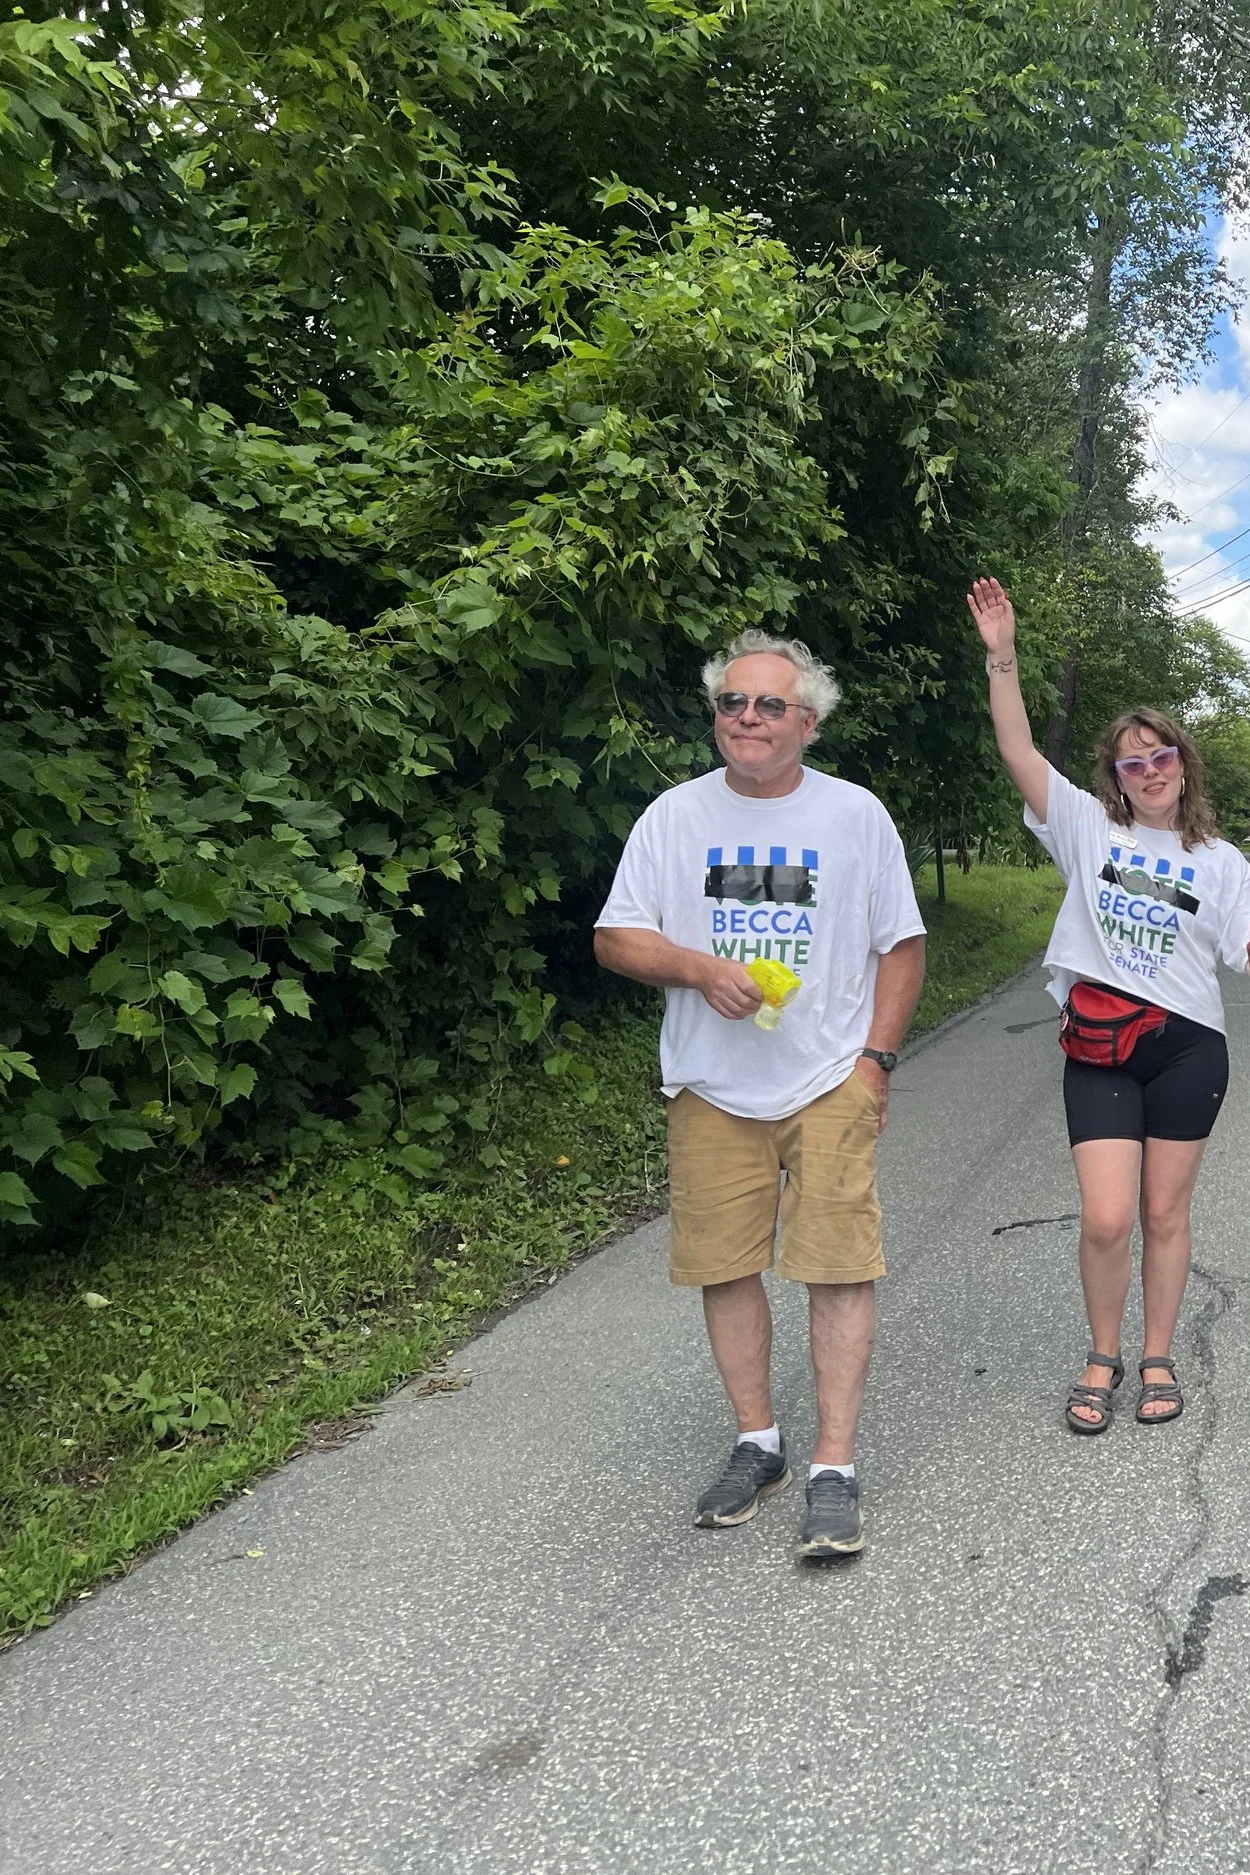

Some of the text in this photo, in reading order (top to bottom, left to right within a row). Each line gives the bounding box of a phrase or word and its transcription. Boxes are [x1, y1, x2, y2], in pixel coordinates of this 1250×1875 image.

[712, 909, 814, 936] BECCA
[1098, 889, 1181, 931] BECCA
[1097, 912, 1176, 955] WHITE
[711, 938, 811, 965] WHITE
[1130, 947, 1168, 969] STATE
